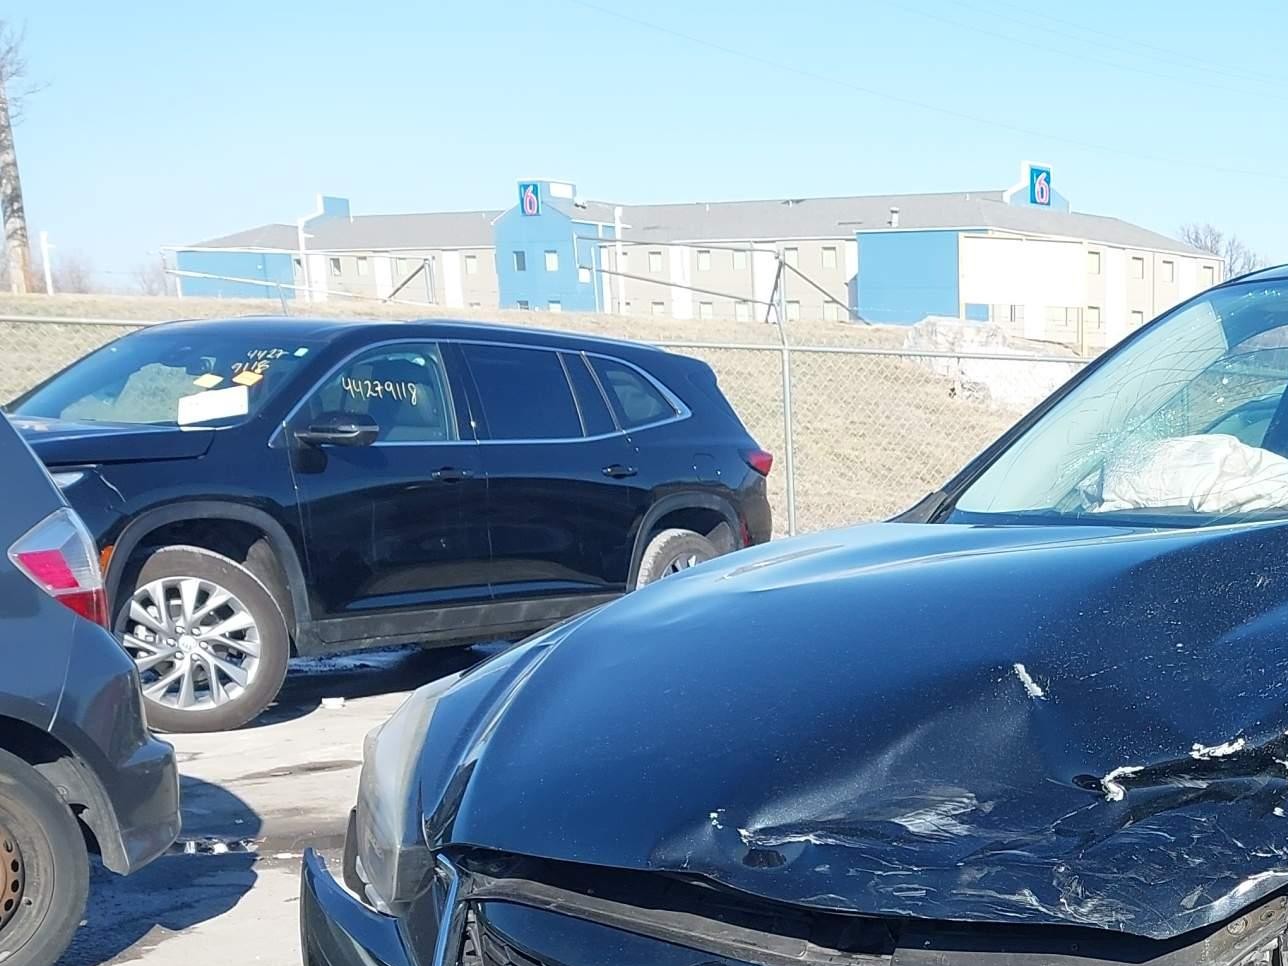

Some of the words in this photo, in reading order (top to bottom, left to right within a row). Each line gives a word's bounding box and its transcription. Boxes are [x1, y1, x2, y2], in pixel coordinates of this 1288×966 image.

[523, 184, 537, 216] 6
[1035, 171, 1049, 203] 6
[341, 376, 417, 406] 44279118
